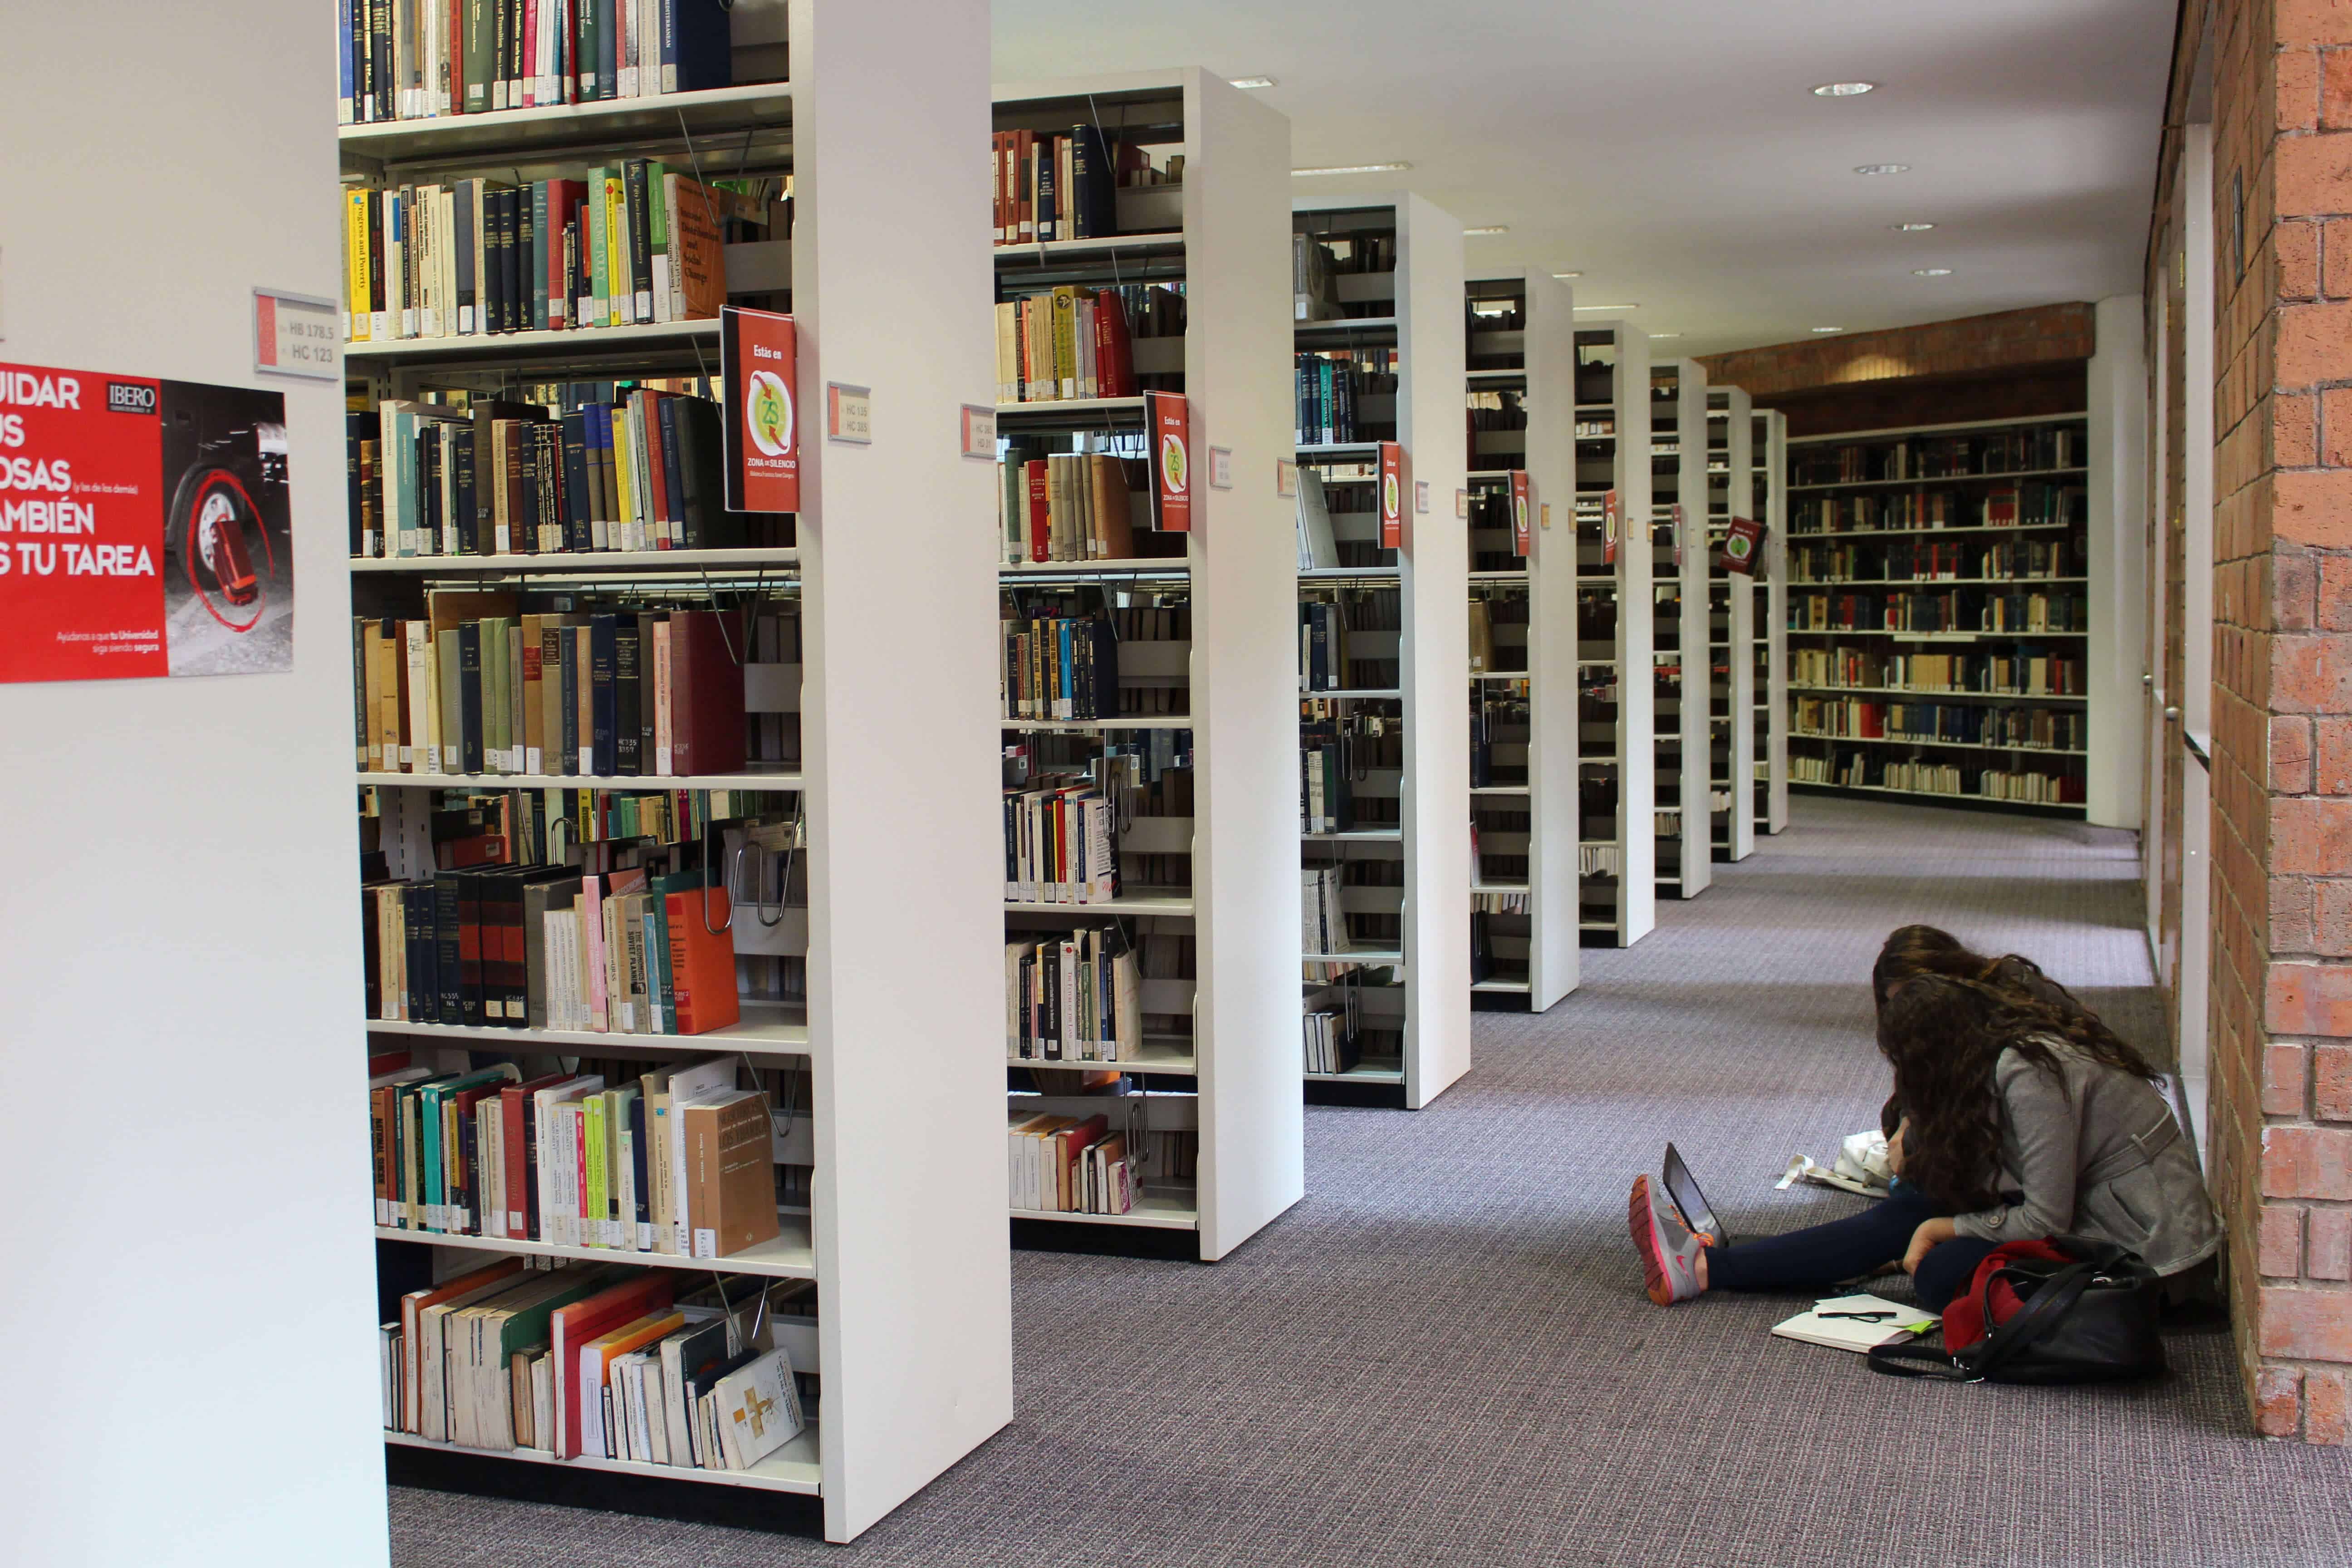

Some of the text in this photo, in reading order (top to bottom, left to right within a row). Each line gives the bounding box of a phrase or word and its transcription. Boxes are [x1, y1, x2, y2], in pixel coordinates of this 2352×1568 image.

[593, 169, 606, 281] MACROECONOMIC POLICY
[681, 221, 719, 241] Distribution
[358, 257, 366, 289] Poverty
[685, 268, 707, 286] Change
[290, 322, 334, 340] HB 178.5
[292, 344, 333, 363] HC 123
[753, 344, 782, 360] Estás en
[0, 371, 155, 410] IDAR IBERO
[846, 405, 856, 415] HC
[0, 413, 25, 447] S
[847, 421, 856, 431] HC
[976, 424, 984, 434] HC
[747, 457, 764, 467] ZONA
[769, 459, 795, 469] SILENCIO
[16, 542, 56, 575] TU
[62, 544, 155, 576] TAREA
[110, 632, 118, 640] tu
[118, 629, 159, 640] Universidad
[134, 644, 160, 654] segura
[628, 931, 636, 955] SOVIET
[375, 1118, 385, 1185] NATIONAL SUICIDE
